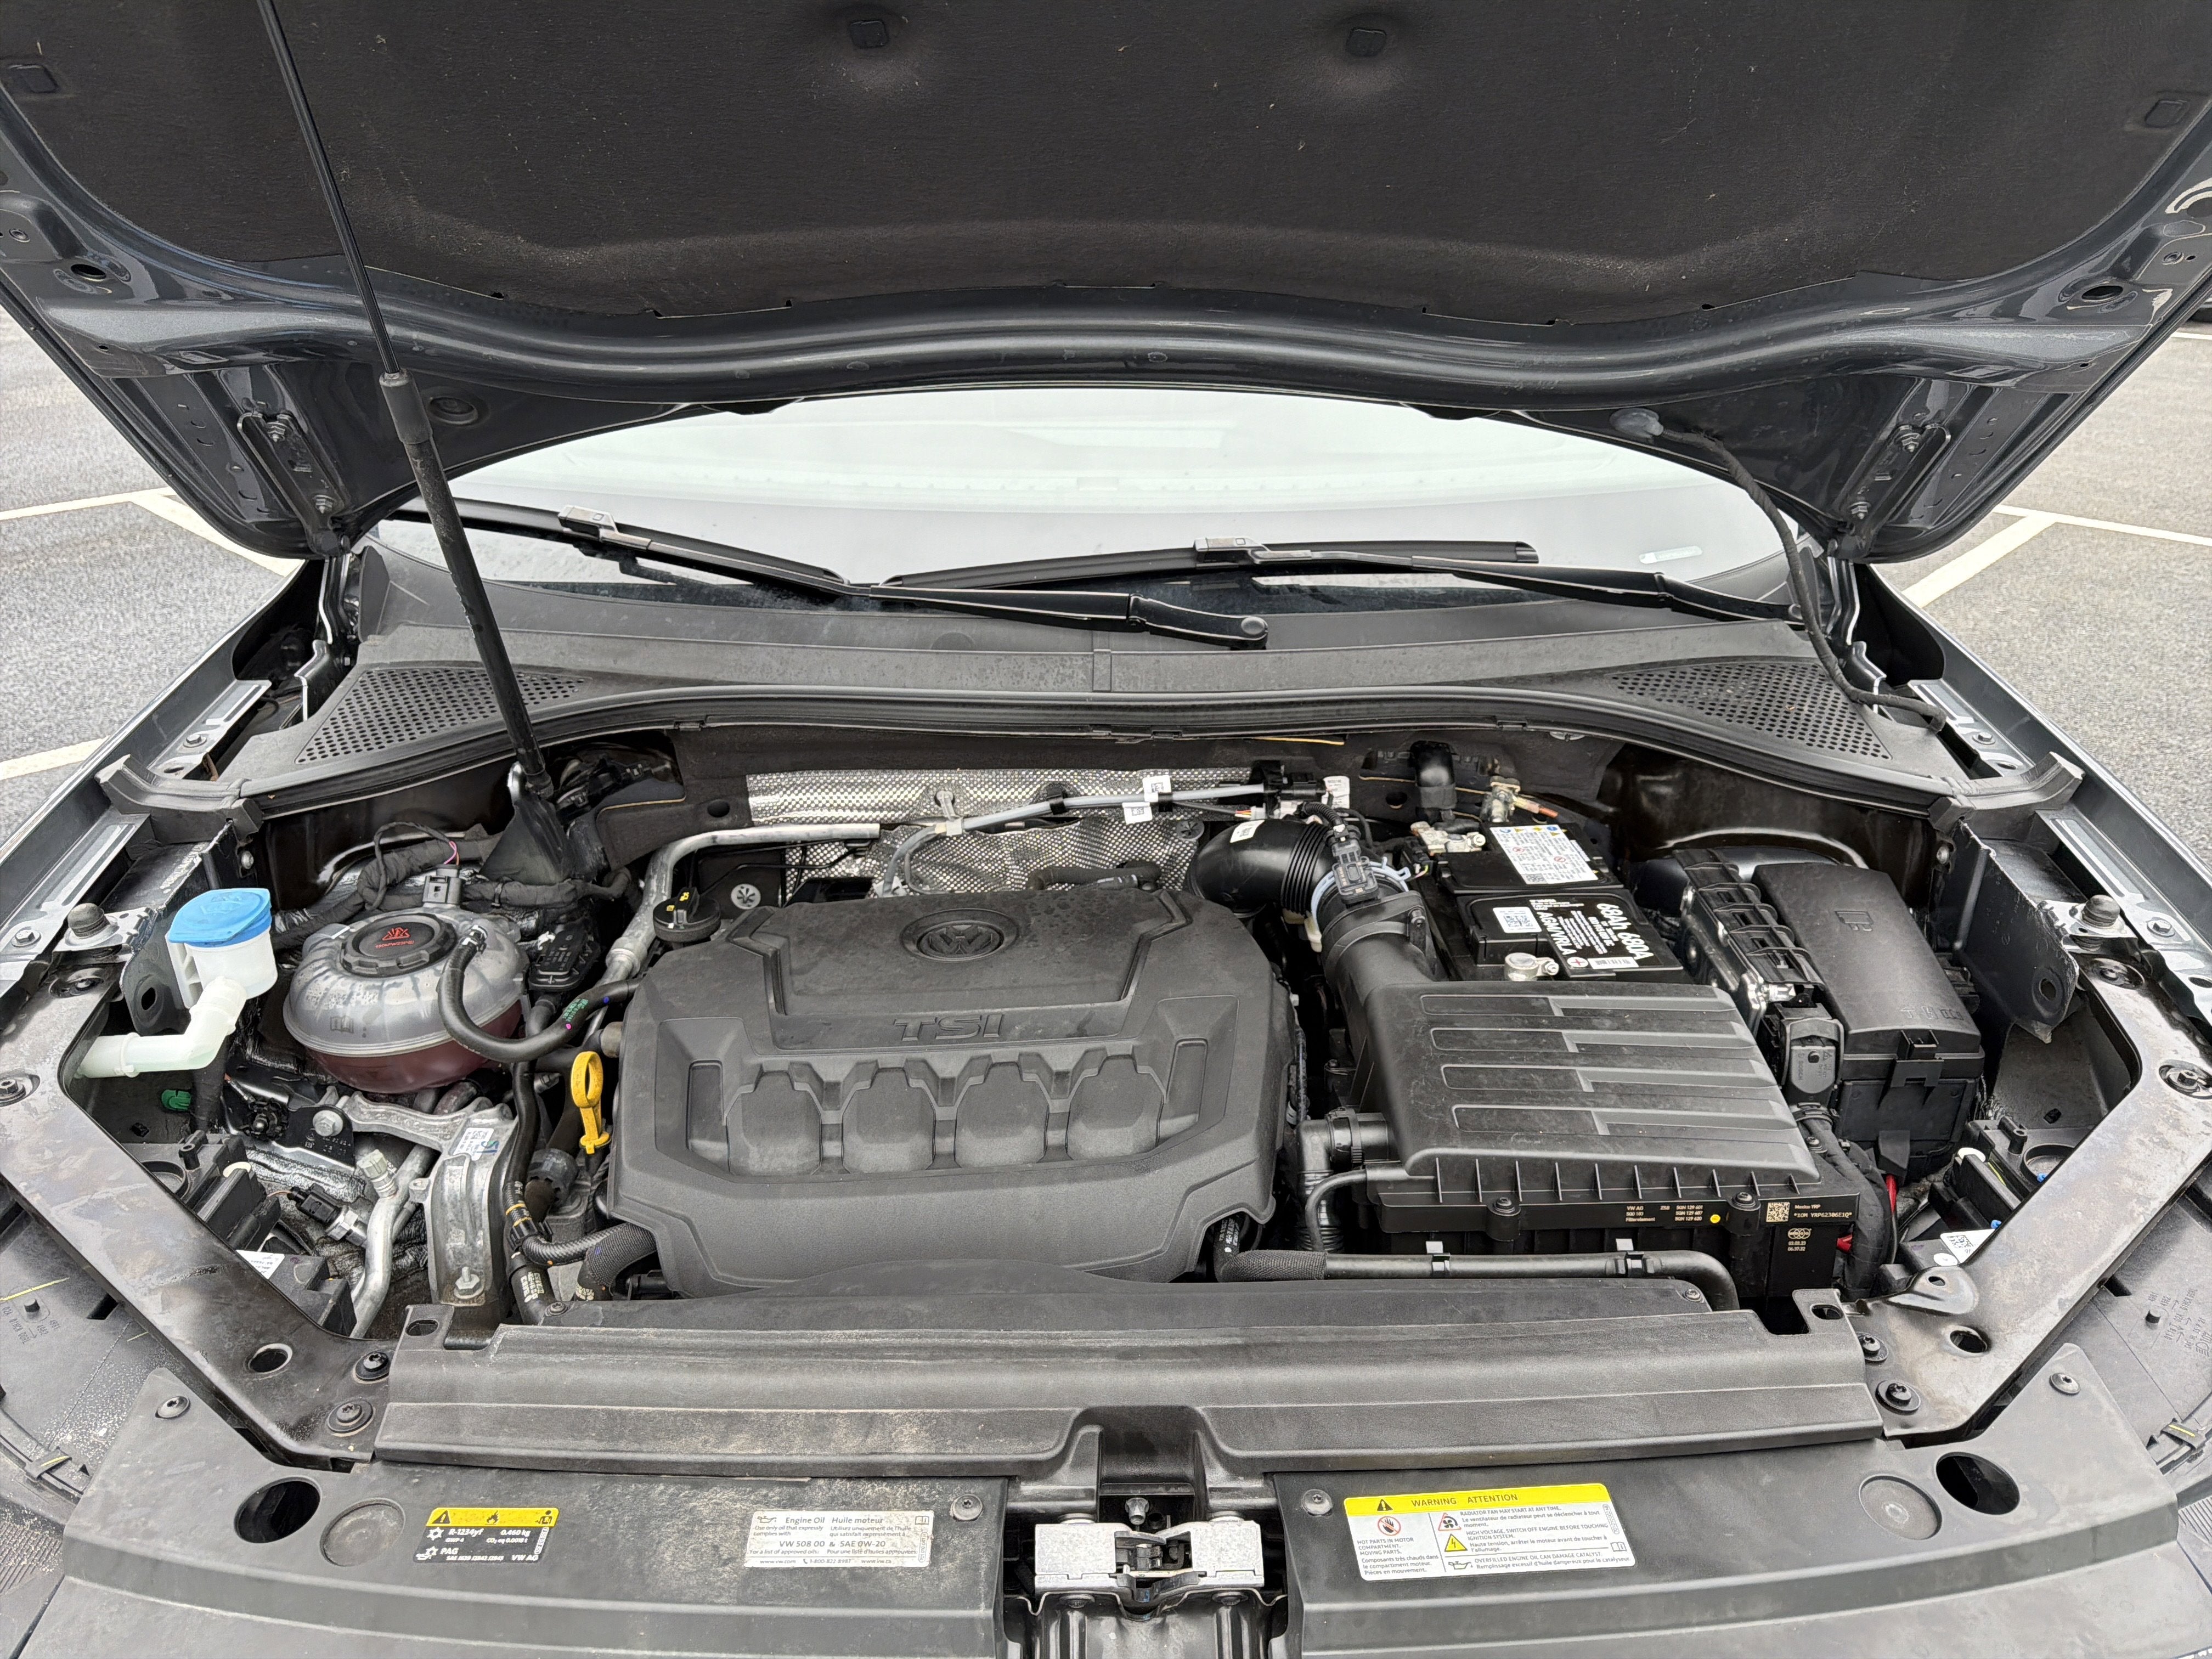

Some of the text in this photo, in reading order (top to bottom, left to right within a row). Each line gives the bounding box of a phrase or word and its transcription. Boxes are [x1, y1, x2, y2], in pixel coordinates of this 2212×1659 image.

[1537, 912, 1577, 955] AGM/VRLA
[1596, 904, 1632, 929] 68Ah
[1617, 932, 1655, 960] 680A
[893, 1014, 1005, 1041] TSI
[1411, 1494, 1518, 1507] WARNING ATTENTION
[448, 1528, 484, 1537] R-1234yf
